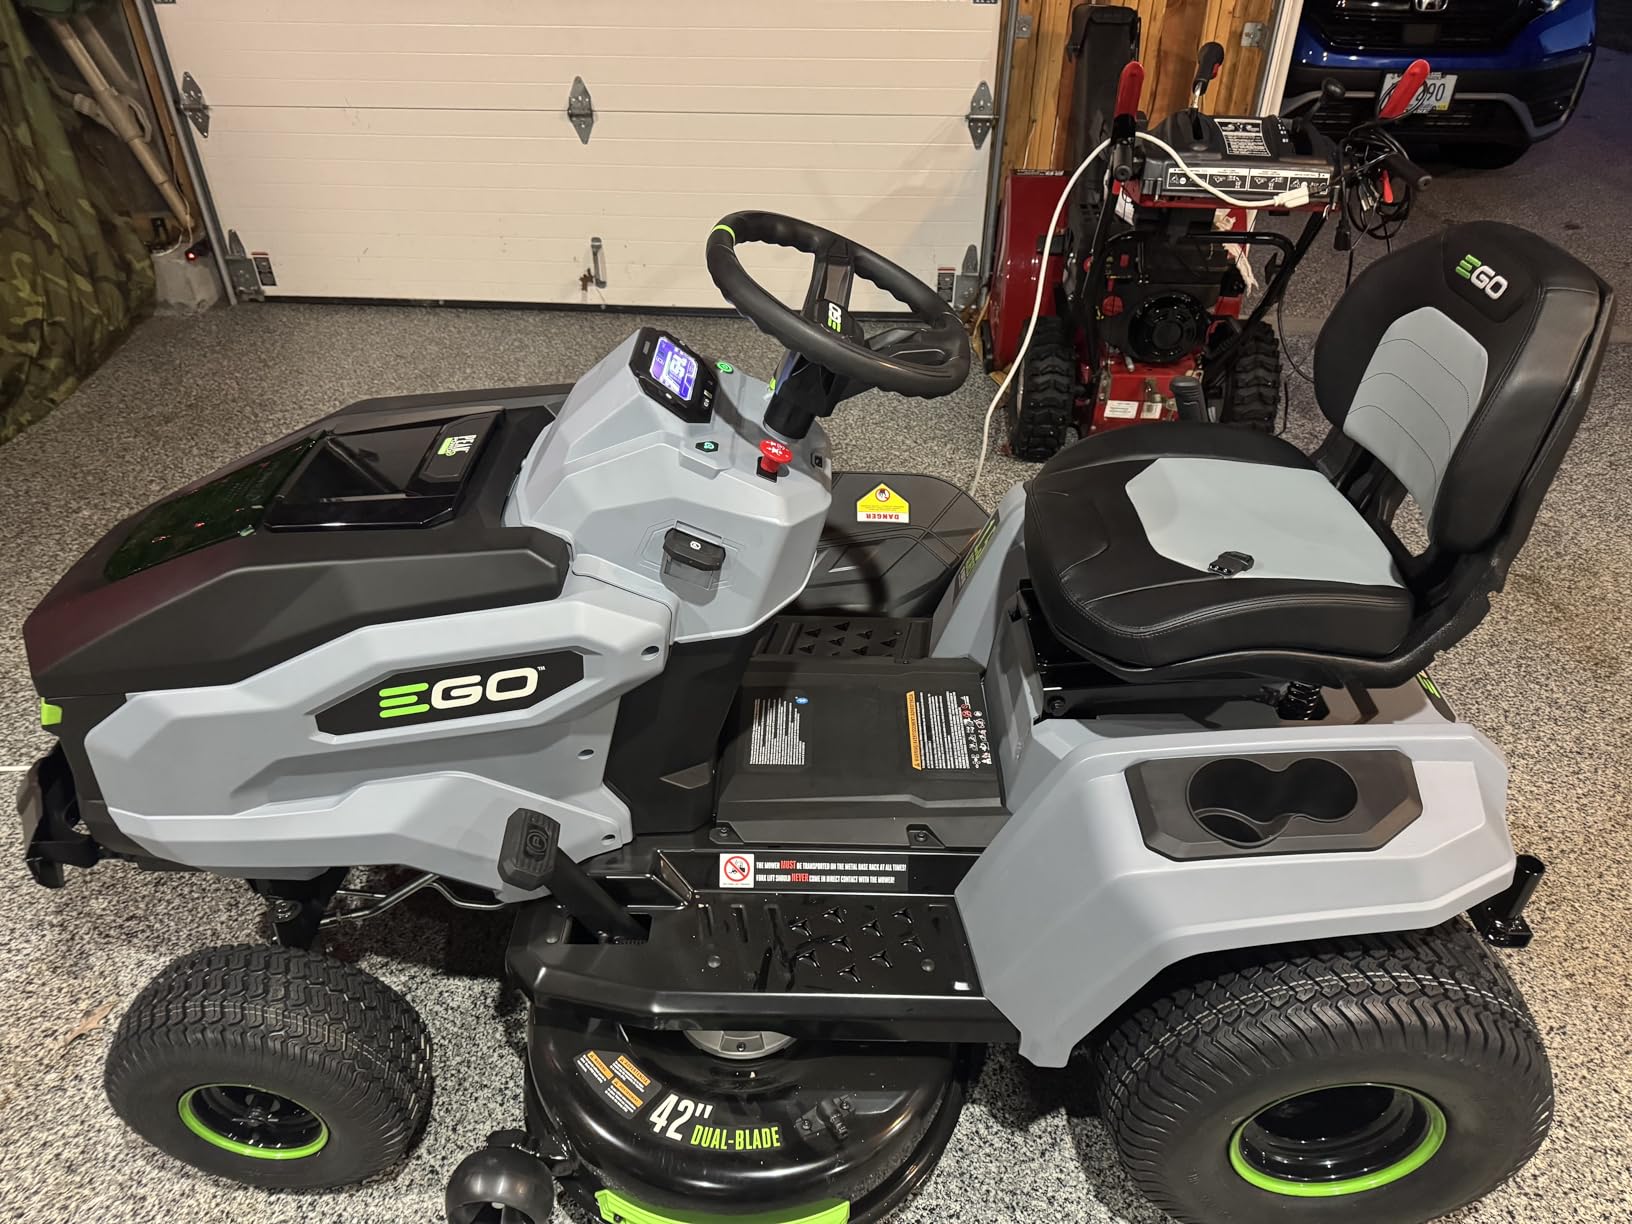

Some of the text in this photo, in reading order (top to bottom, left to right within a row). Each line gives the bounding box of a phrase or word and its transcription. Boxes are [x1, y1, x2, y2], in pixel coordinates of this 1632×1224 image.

[1455, 254, 1508, 300] EGO
[828, 302, 842, 333] EGO
[379, 667, 539, 718] EGO
[780, 860, 796, 870] MUST
[792, 872, 808, 882] NEVER
[649, 1093, 713, 1141] 42"
[690, 1124, 780, 1151] DUAL-BLADE
